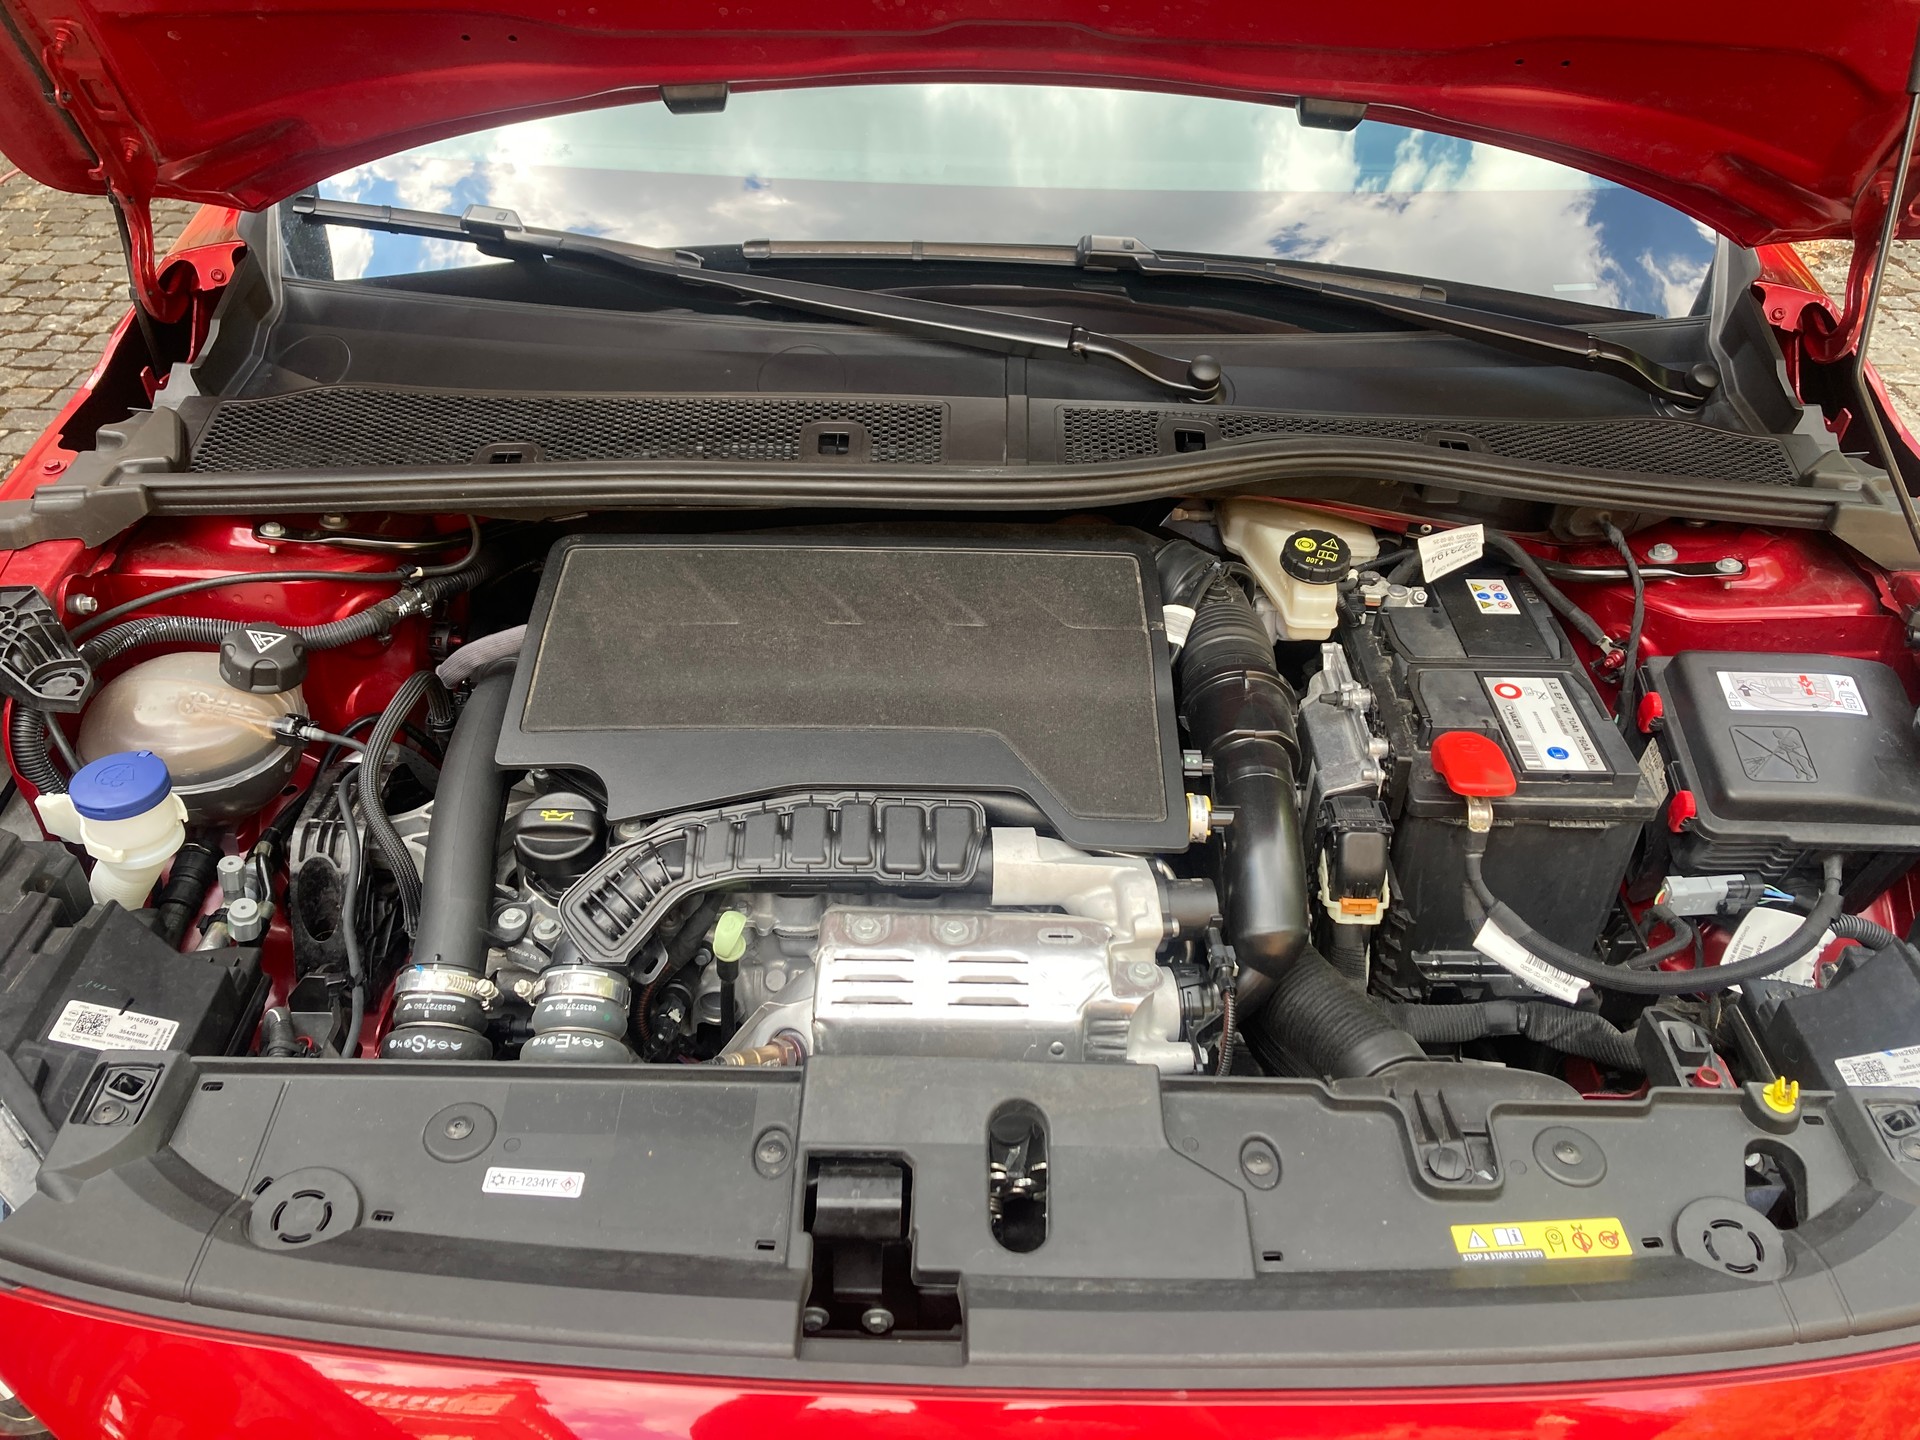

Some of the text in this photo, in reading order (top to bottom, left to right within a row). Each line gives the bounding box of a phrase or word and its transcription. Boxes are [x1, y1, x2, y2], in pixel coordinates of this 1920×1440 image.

[1305, 556, 1319, 565] DOT
[1508, 708, 1522, 729] VARTA
[1560, 703, 1571, 715] 12V
[1567, 717, 1580, 733] 70Ah
[411, 1034, 426, 1053] S
[555, 1033, 571, 1048] E
[507, 1175, 559, 1188] R-1234YF
[1463, 1250, 1544, 1262] STOP & START SYSTEM
